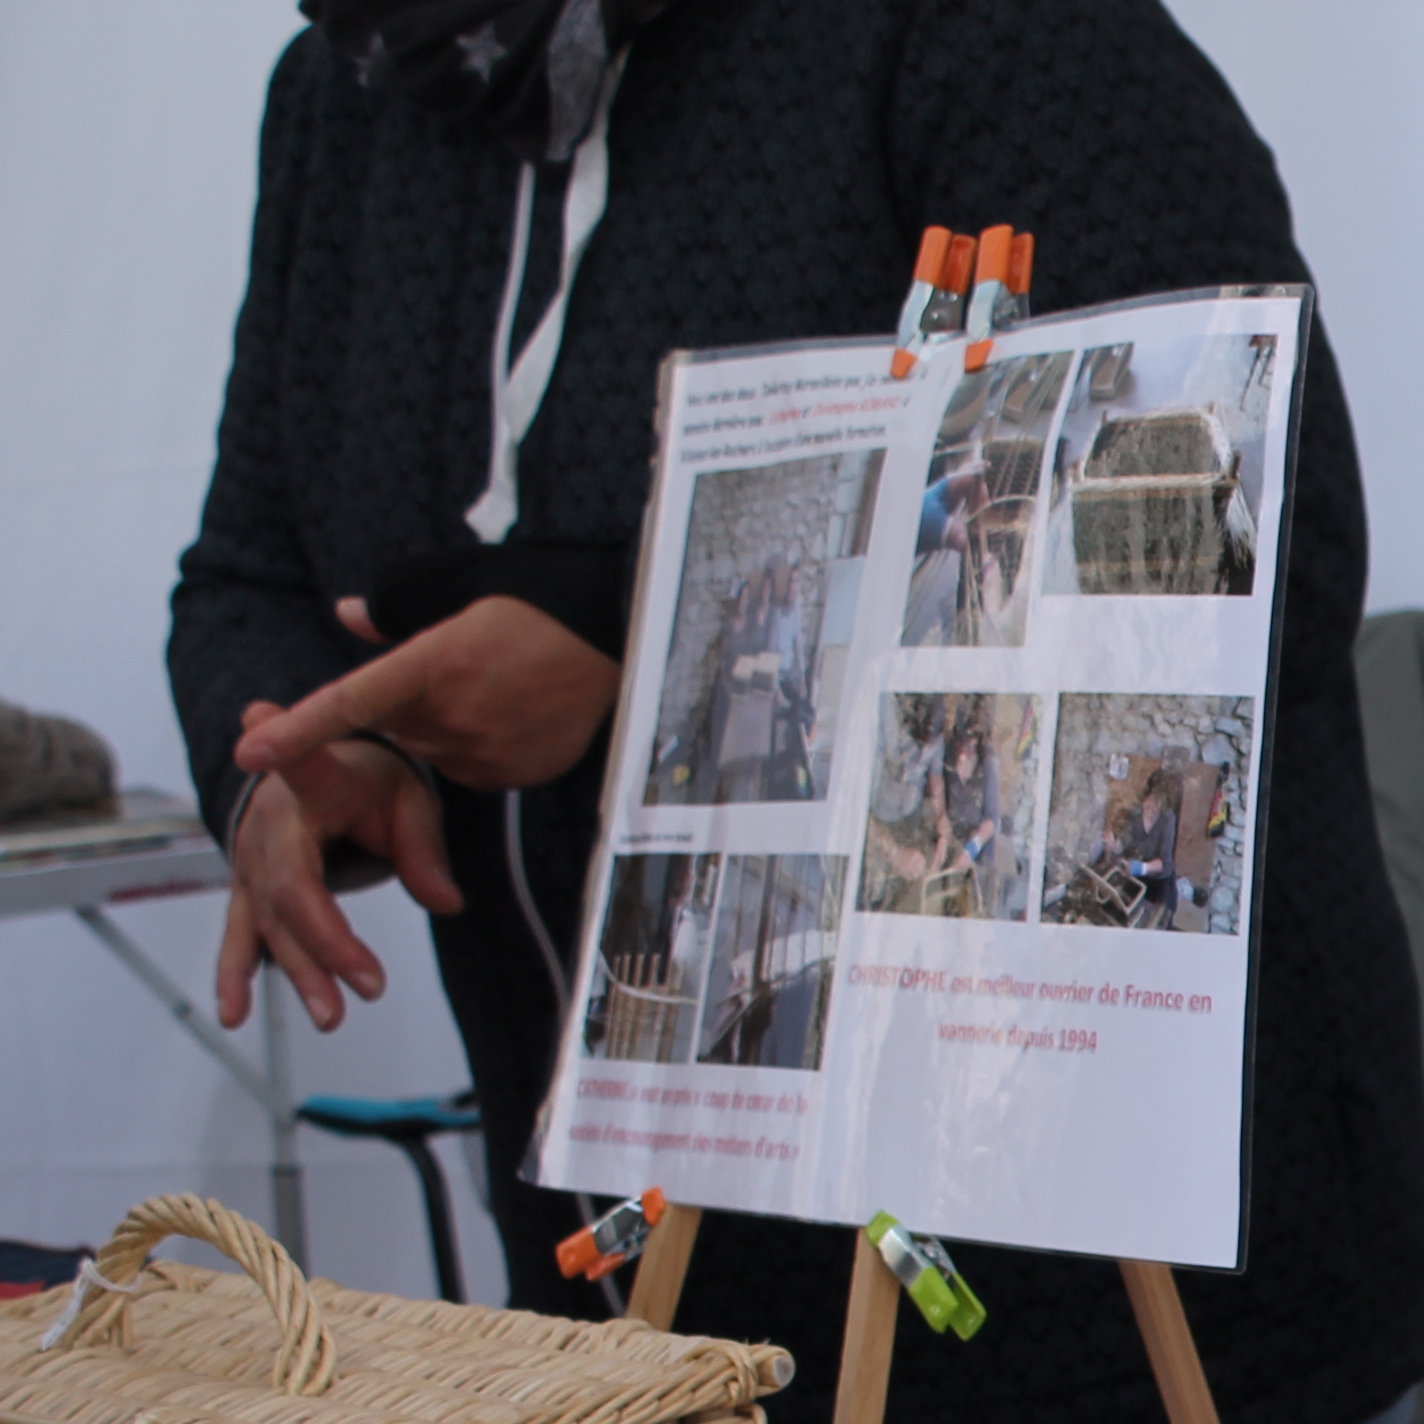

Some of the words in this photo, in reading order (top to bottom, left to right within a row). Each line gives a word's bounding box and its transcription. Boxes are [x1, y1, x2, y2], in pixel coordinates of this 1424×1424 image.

[848, 963, 947, 993] CHRISTOPHE
[951, 974, 974, 994] est
[976, 973, 1036, 998] meilleur
[1039, 979, 1095, 1002] ouvrier
[1099, 982, 1121, 1007] de
[1124, 984, 1185, 1011] France
[1188, 993, 1213, 1013] en
[938, 1022, 1001, 1045] vannerie
[1008, 1024, 1055, 1053] depuis
[1058, 1028, 1097, 1053] 1994
